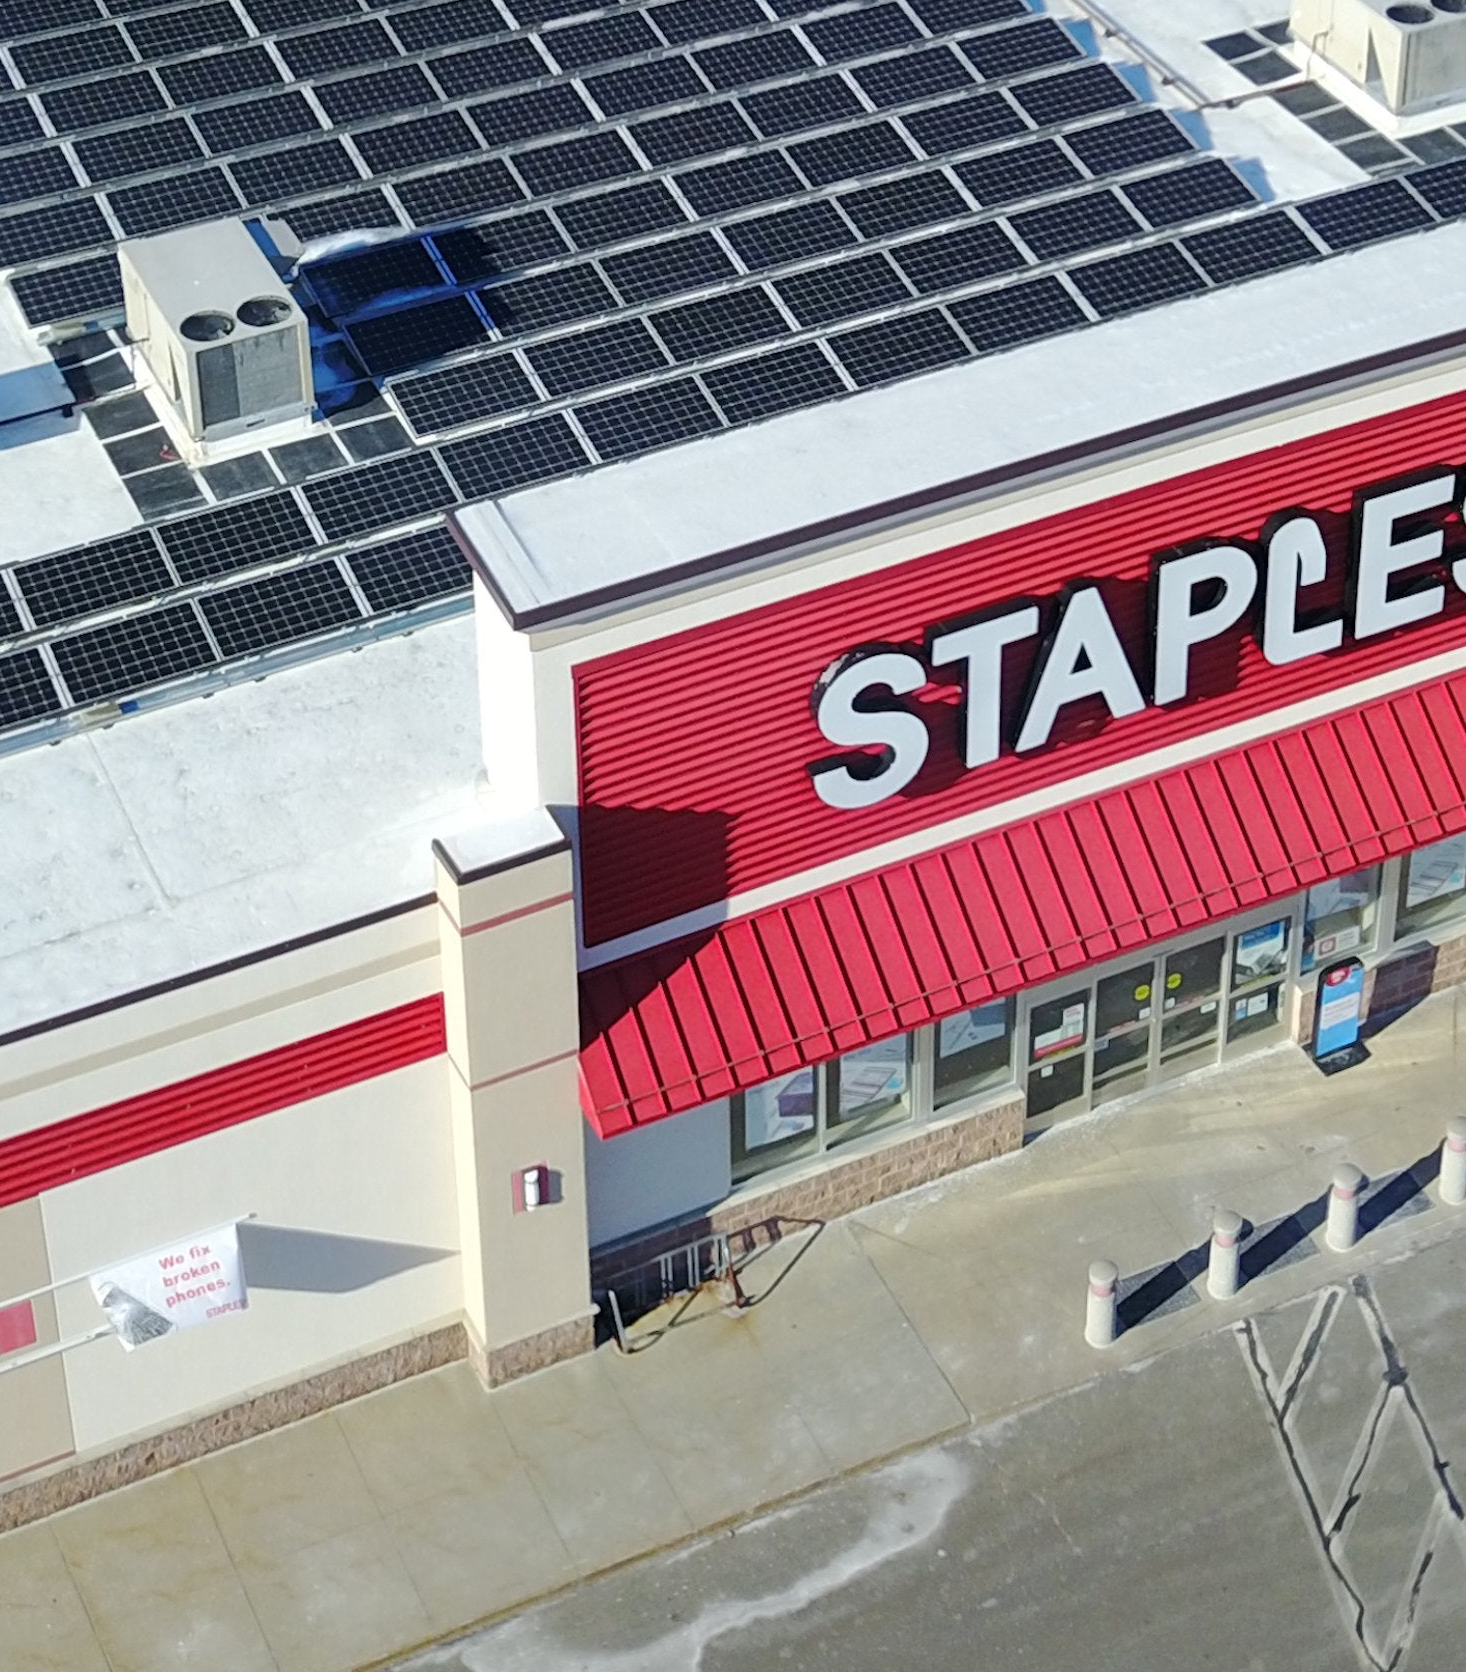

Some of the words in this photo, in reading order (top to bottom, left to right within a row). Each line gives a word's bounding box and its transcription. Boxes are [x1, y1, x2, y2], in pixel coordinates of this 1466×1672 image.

[158, 1254, 185, 1270] We
[189, 1245, 212, 1259] fix
[162, 1261, 221, 1288] broken
[165, 1279, 231, 1308] phones.
